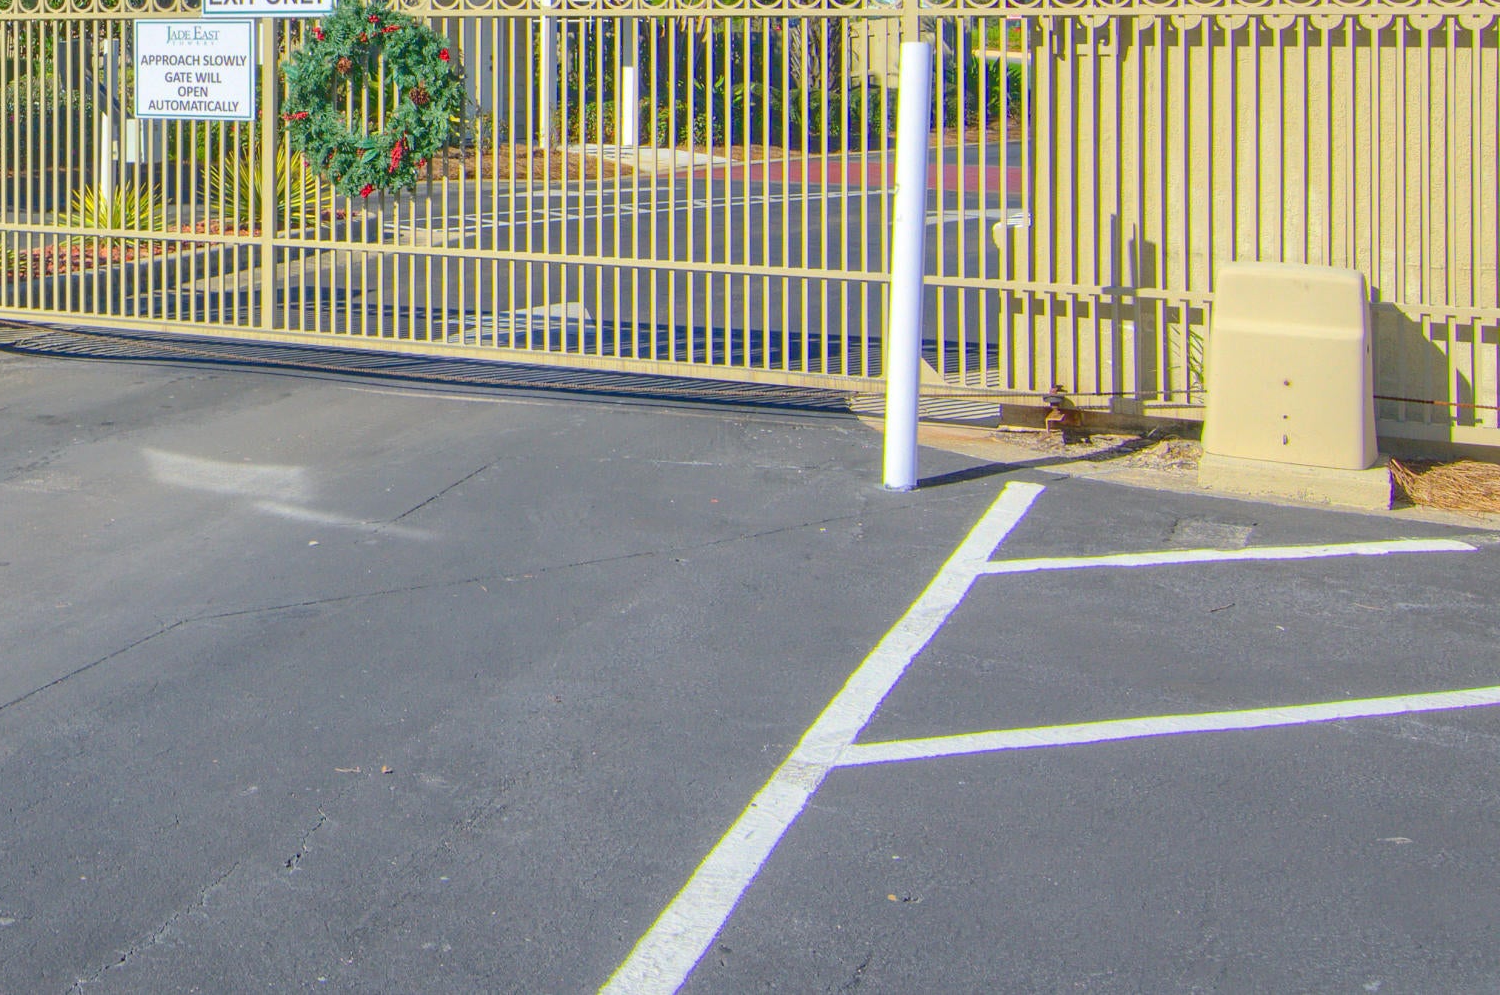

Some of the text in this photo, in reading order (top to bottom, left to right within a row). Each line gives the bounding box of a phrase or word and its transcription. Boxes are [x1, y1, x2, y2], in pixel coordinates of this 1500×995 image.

[166, 25, 220, 44] JADE EAST
[140, 55, 247, 67] APPROACH SLOWLY
[164, 72, 222, 84] GATE WILL
[177, 86, 209, 97] OPEN
[148, 100, 239, 112] AUTOMATICALLY
